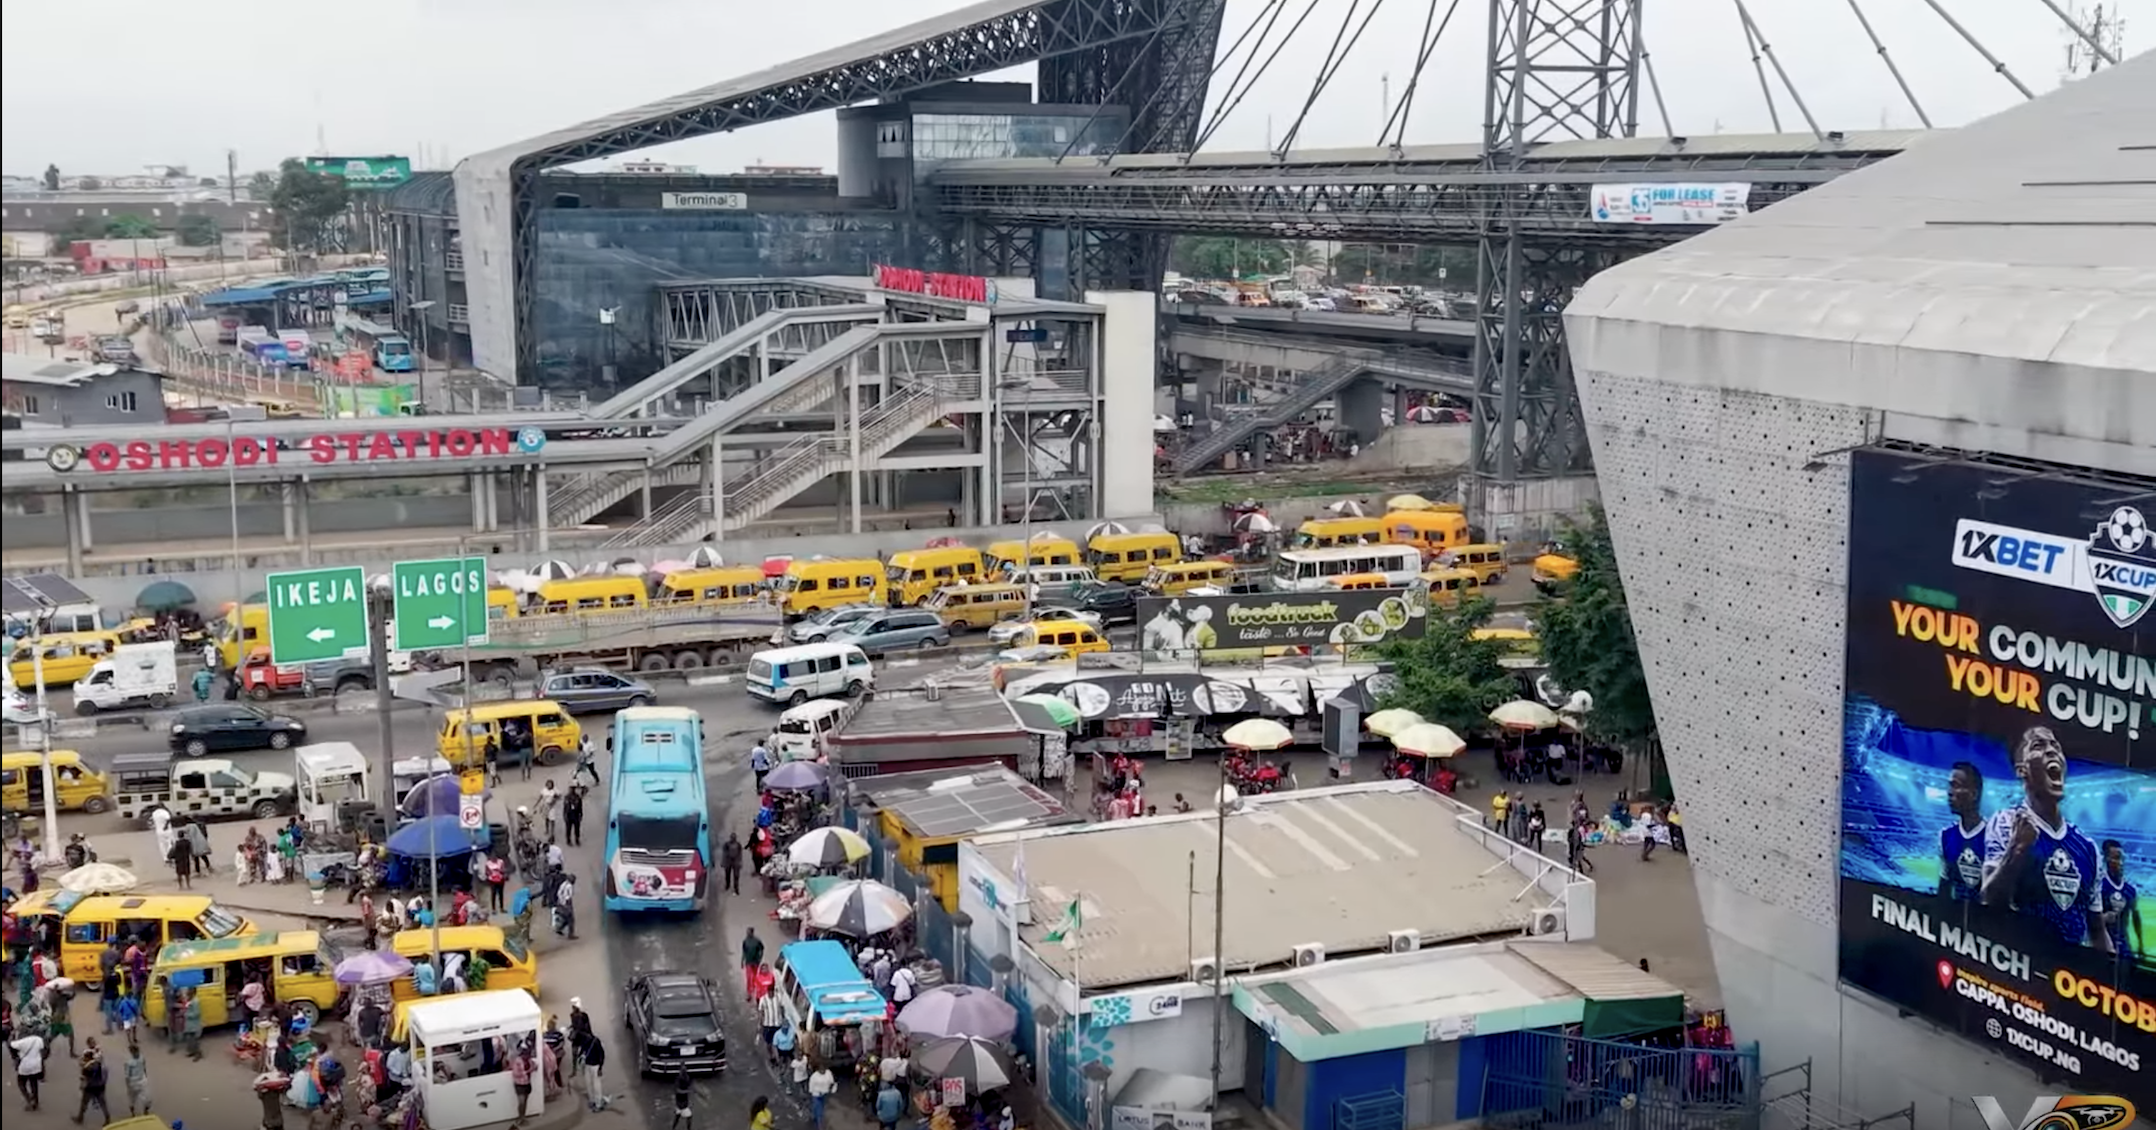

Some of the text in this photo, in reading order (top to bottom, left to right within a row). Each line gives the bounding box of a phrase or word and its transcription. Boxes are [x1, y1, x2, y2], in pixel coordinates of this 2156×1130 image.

[672, 193, 738, 208] Terminal 3
[1652, 187, 1715, 200] FOR LEASE
[88, 428, 510, 472] OSHODI STATION
[1962, 529, 2065, 574] 1XBET
[401, 570, 480, 597] LAGOS
[2095, 562, 2156, 589] 1XCUP
[276, 578, 356, 608] IKEJA
[1227, 600, 1339, 625] foodtruck
[1890, 599, 1981, 655] YOUR
[1239, 625, 1272, 640] taste
[1285, 625, 1300, 638] So
[1302, 624, 1326, 638] Good
[1945, 653, 2142, 741] YOUR CUP!
[1872, 893, 1936, 943] FINAL
[1940, 921, 2030, 981] MATCH
[1955, 977, 2141, 1072] CAPPA, OSHODI, LAGOS
[2006, 1027, 2081, 1075] 1XCUP.NG
[1177, 1118, 1206, 1130] BANK
